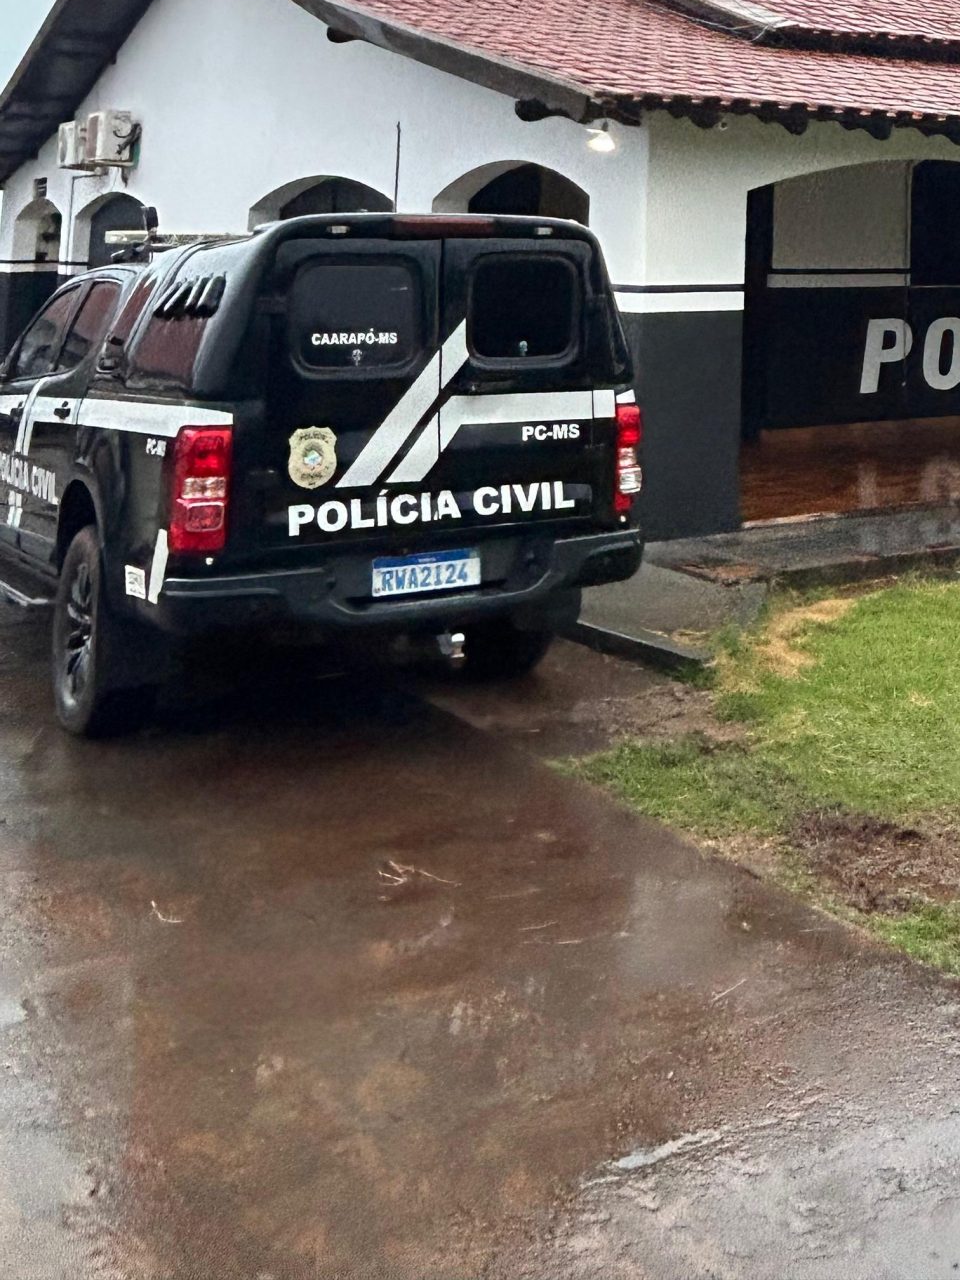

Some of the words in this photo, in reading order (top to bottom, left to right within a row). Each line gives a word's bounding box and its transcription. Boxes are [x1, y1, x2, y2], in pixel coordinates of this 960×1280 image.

[311, 328, 398, 345] CAARAPÓ-MS
[521, 424, 580, 441] PC-MS
[288, 490, 462, 536] POLÍCIA
[473, 481, 576, 515] CIVIL
